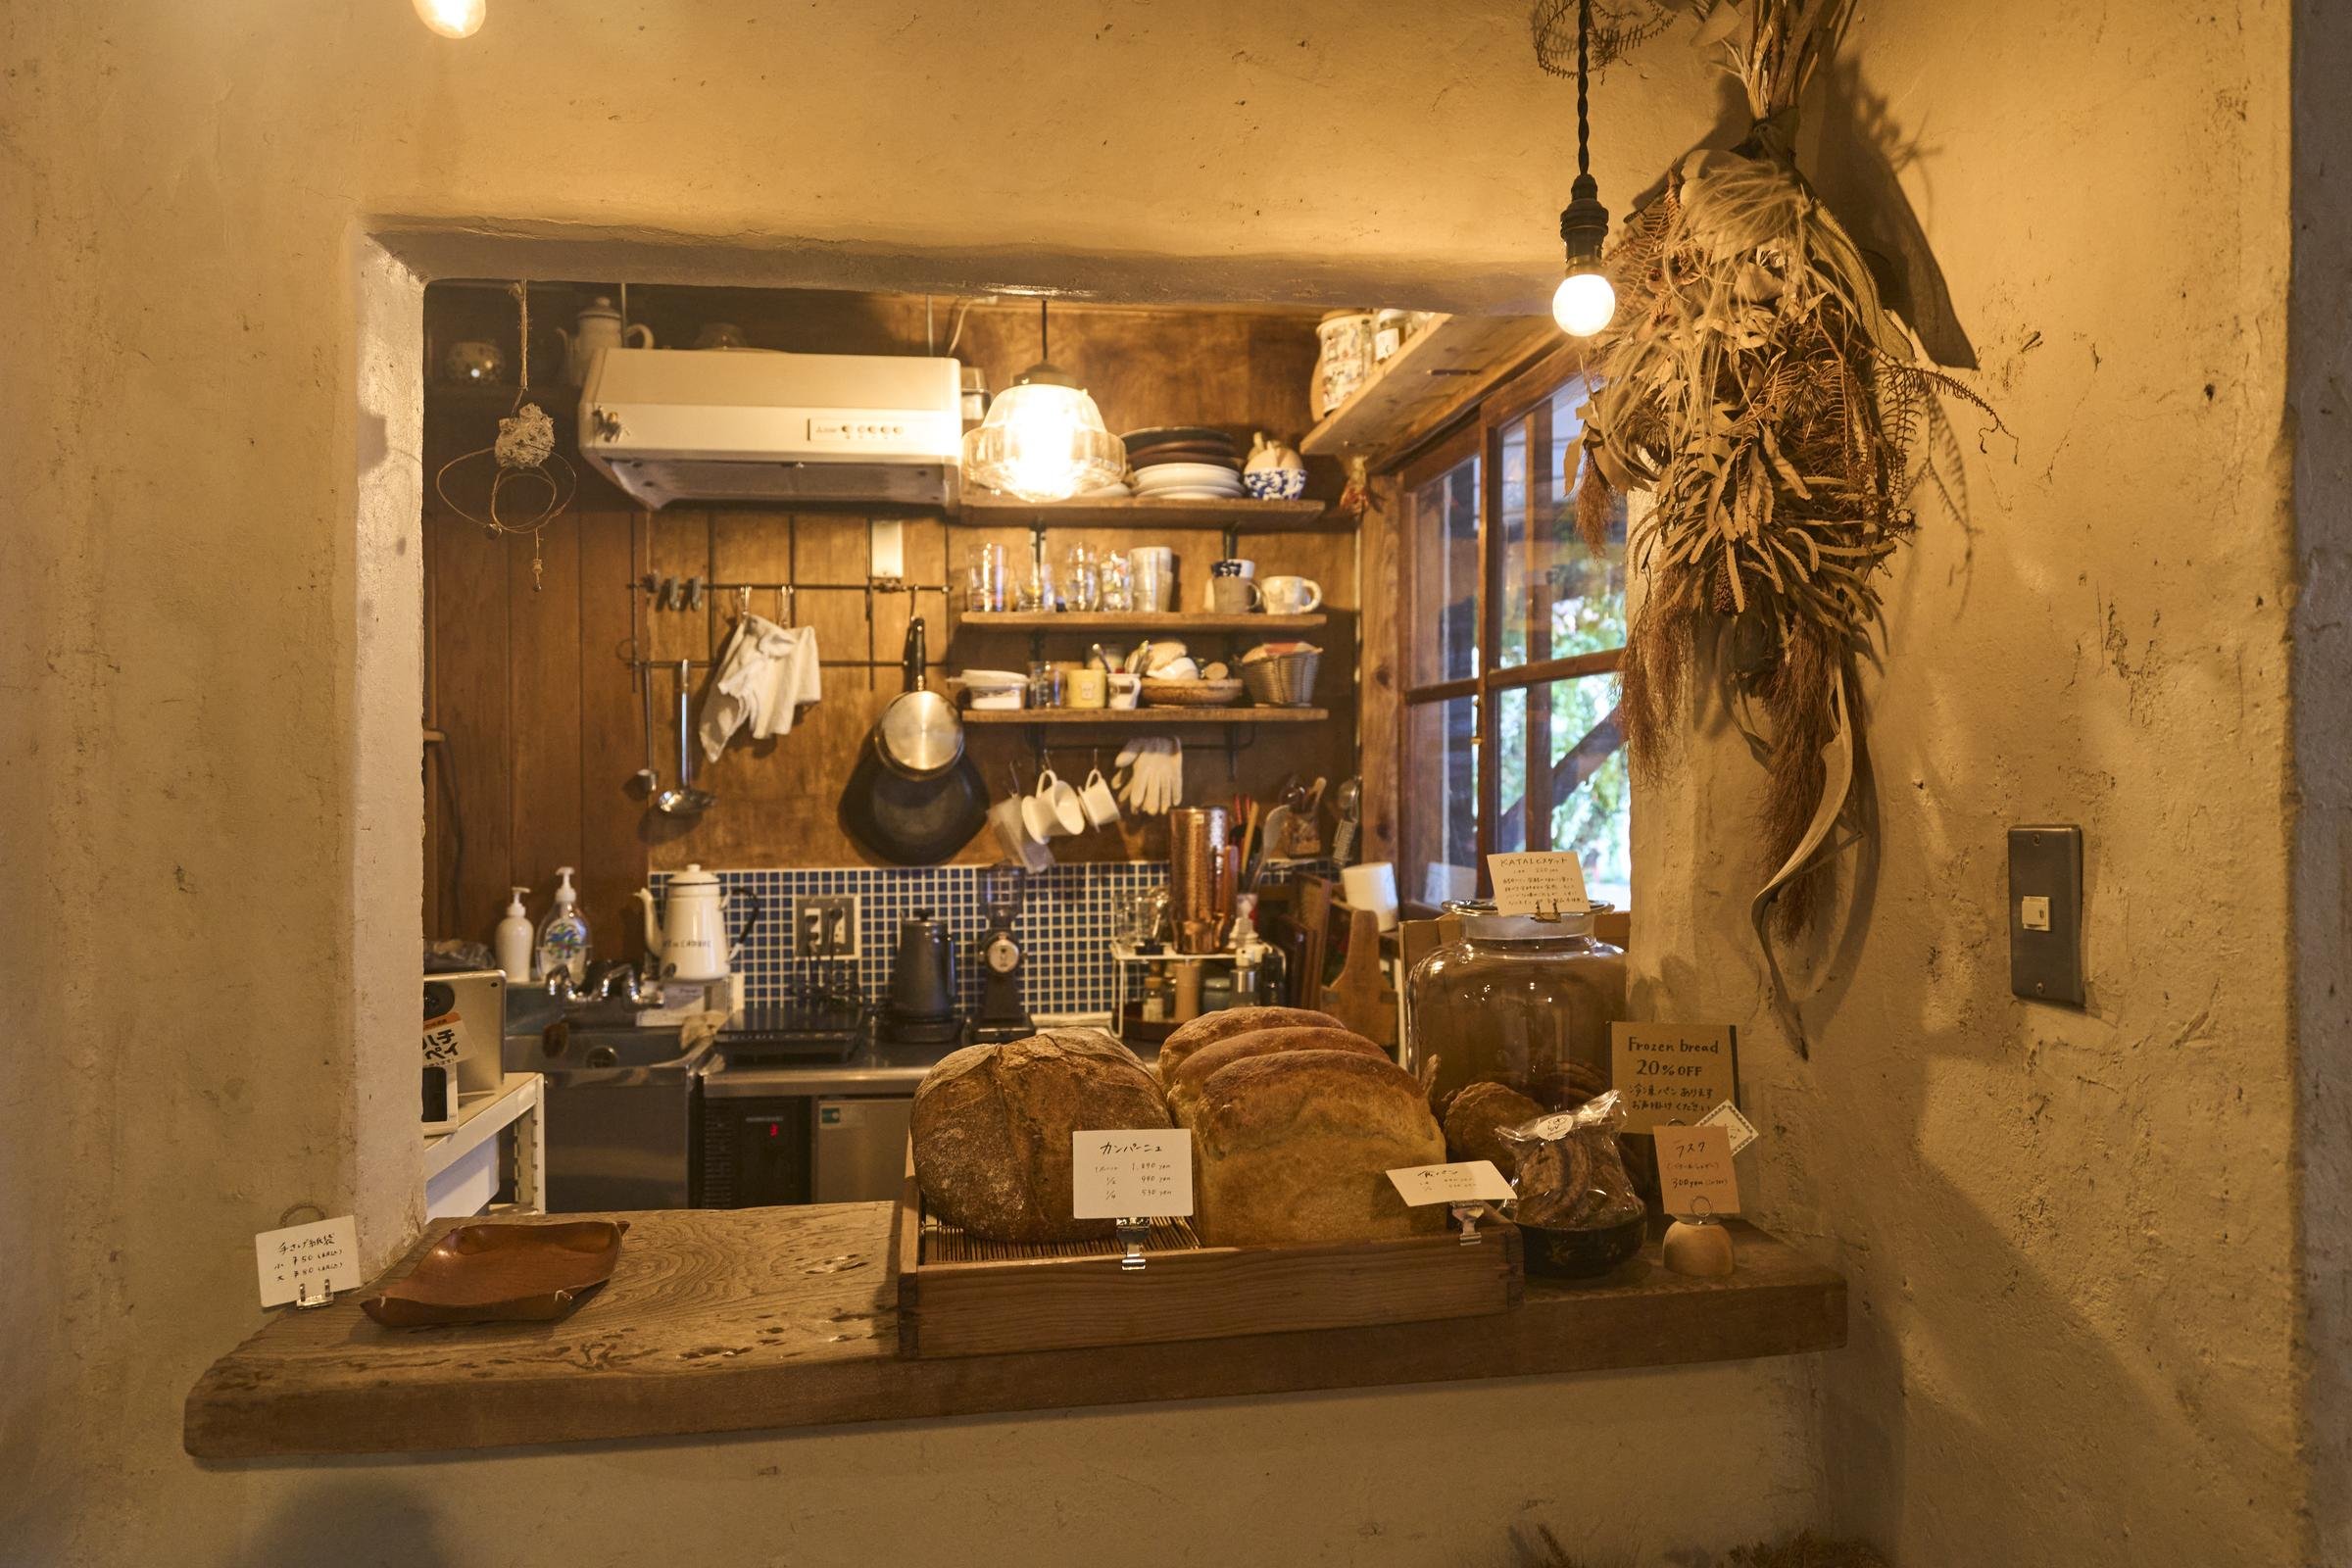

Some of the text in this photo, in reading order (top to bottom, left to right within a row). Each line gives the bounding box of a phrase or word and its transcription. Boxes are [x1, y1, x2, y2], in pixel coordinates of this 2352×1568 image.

[1628, 1036, 1719, 1054] Frozen bread
[1100, 1142, 1162, 1155] カンパーニュ
[1675, 1141, 1705, 1158] ラスク
[278, 1233, 335, 1254] 手さげ紙袋
